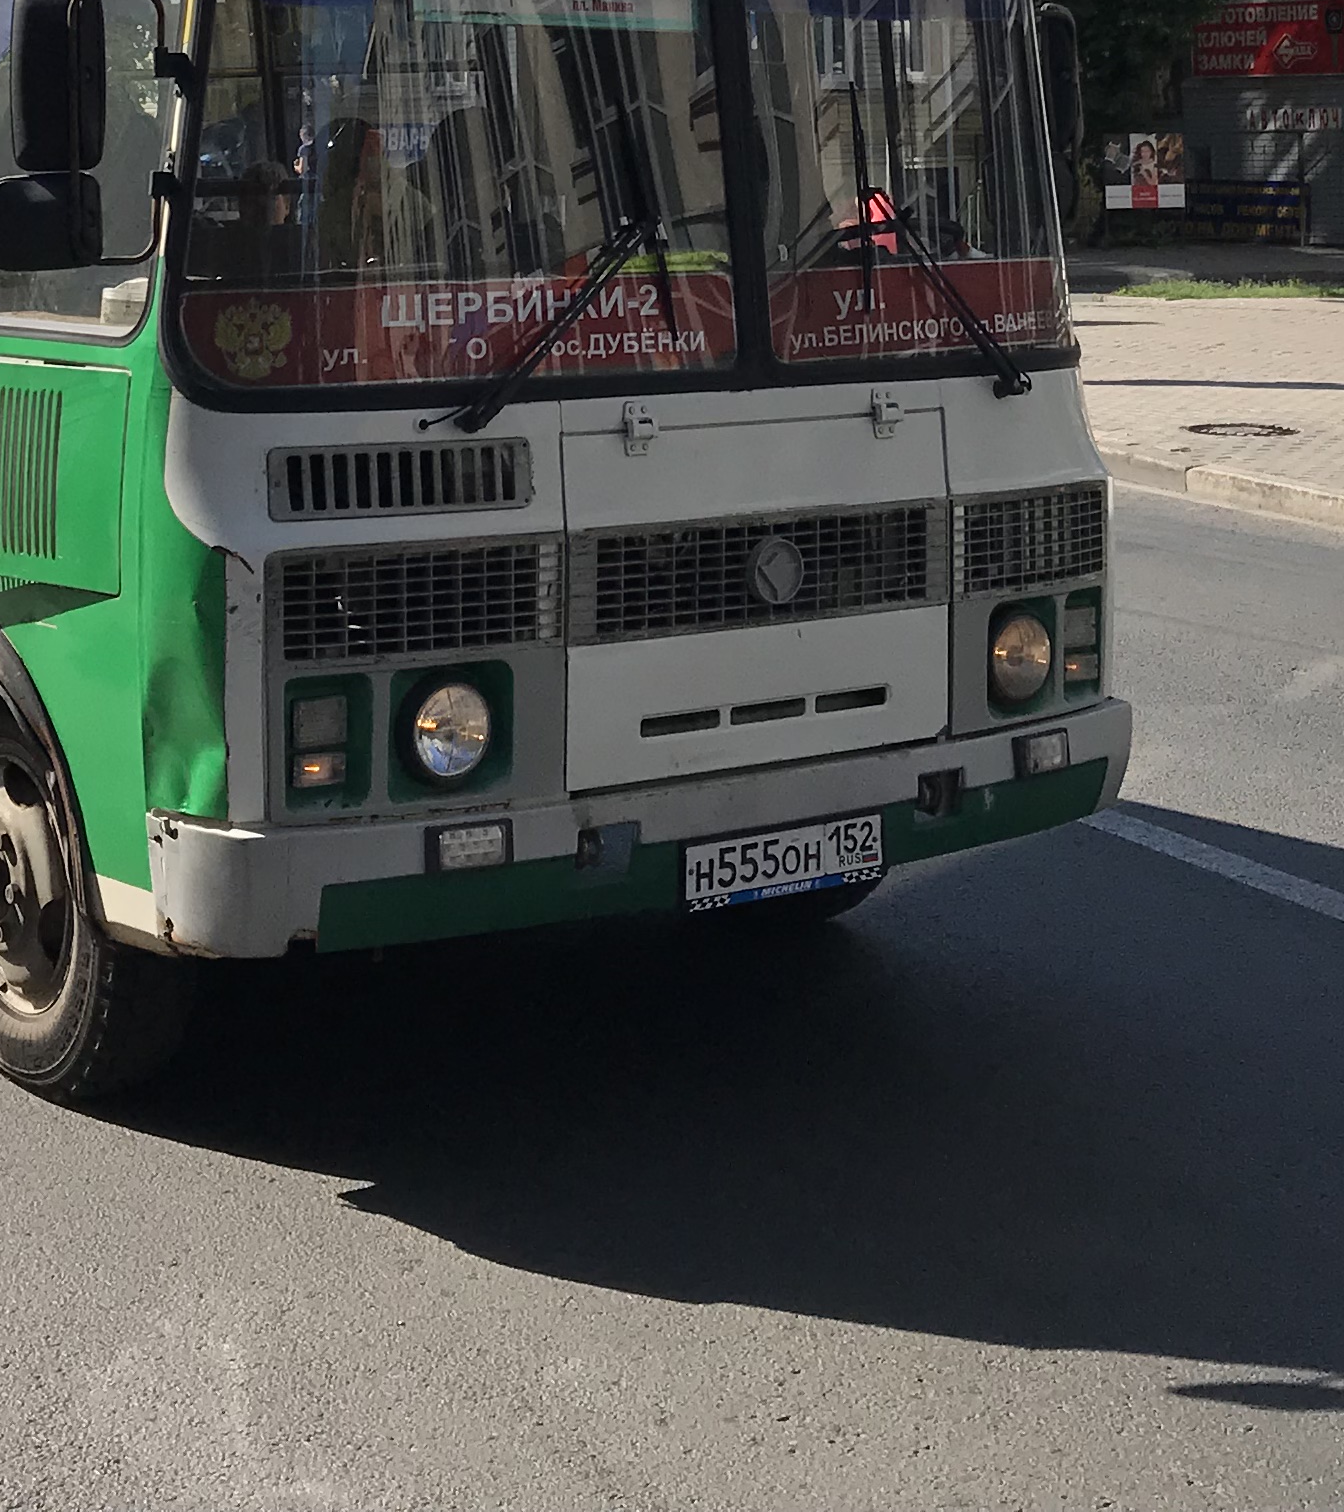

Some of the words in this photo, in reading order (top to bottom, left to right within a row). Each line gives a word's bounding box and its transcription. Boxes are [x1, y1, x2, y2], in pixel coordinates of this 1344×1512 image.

[1198, 26, 1267, 48] КЛЮЧЕЙ
[1198, 52, 1255, 71] ЗАМКИ
[833, 288, 887, 321] ул.
[550, 327, 705, 359] ос.ДУБЁНКИ
[323, 348, 368, 372] ул.
[827, 820, 873, 856] 152
[838, 853, 862, 868] RUS
[761, 880, 813, 897] MICHELIN
